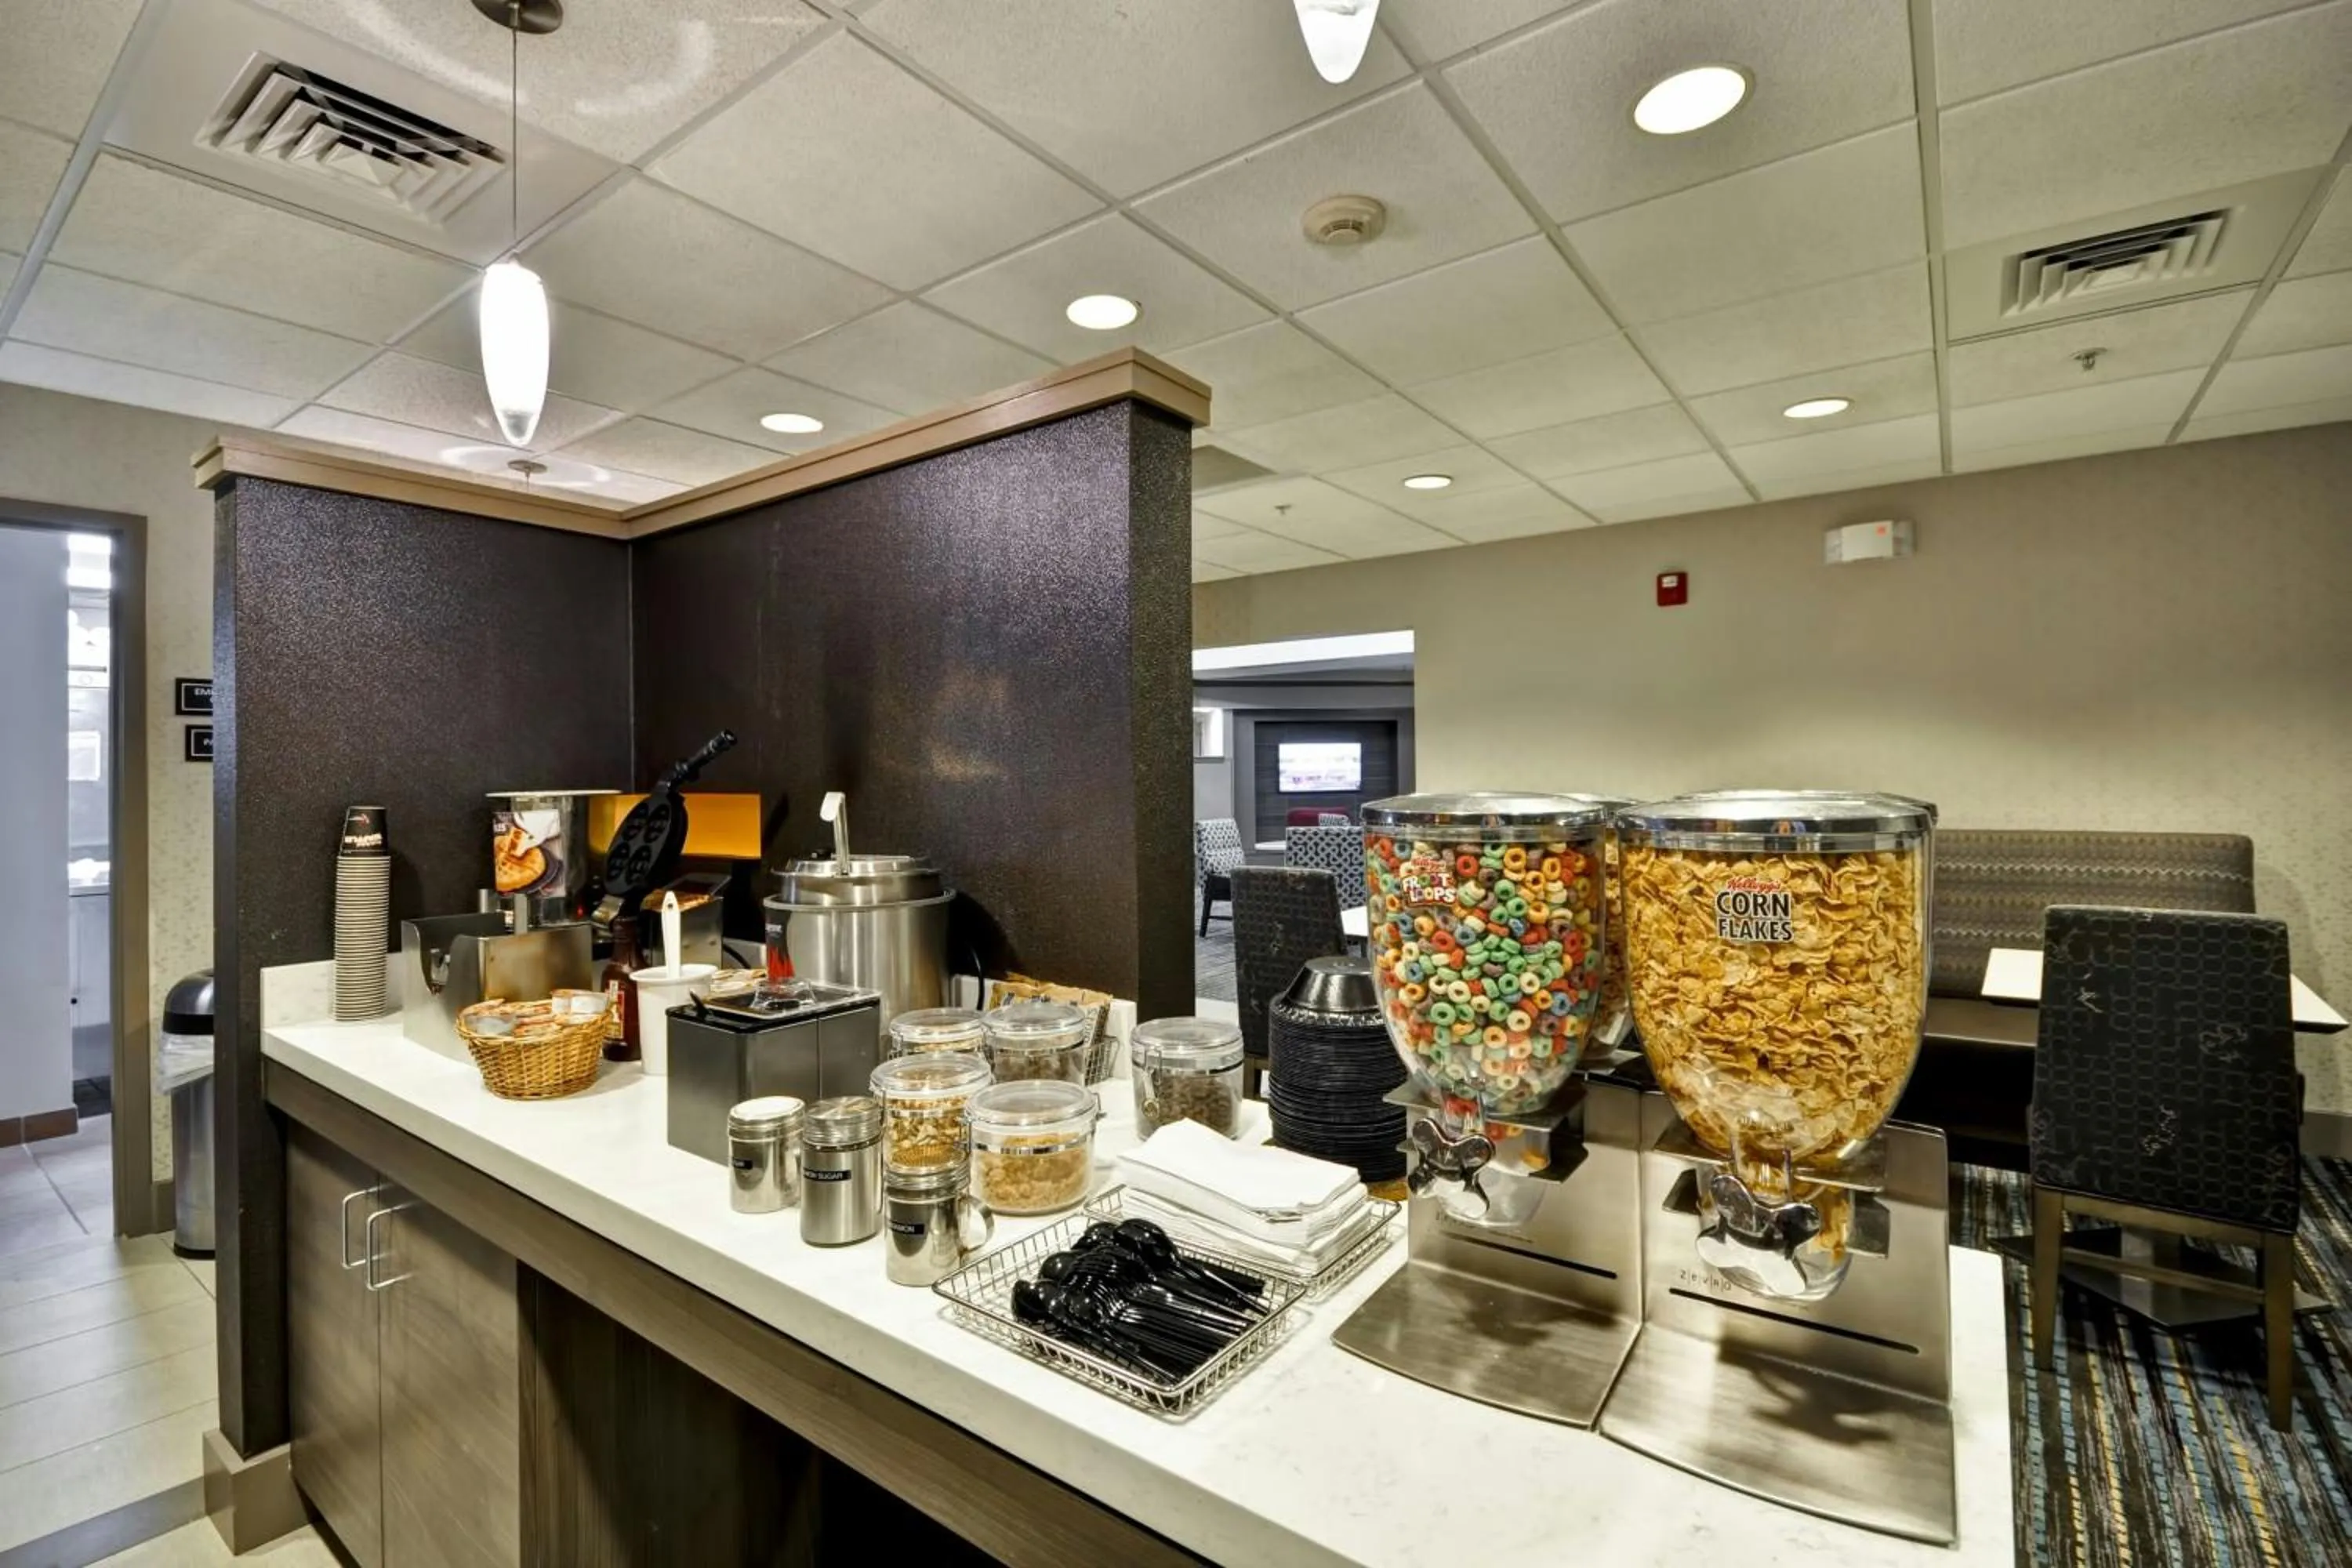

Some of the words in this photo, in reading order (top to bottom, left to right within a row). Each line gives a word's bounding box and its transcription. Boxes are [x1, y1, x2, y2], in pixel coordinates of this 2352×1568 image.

[1403, 873, 1450, 892] FROOT
[1727, 877, 1780, 892] Kellogg's
[1410, 886, 1456, 902] LOOPS
[1716, 891, 1790, 916] CORN
[1718, 918, 1792, 941] FLAKES
[818, 1171, 843, 1180] SUGAR
